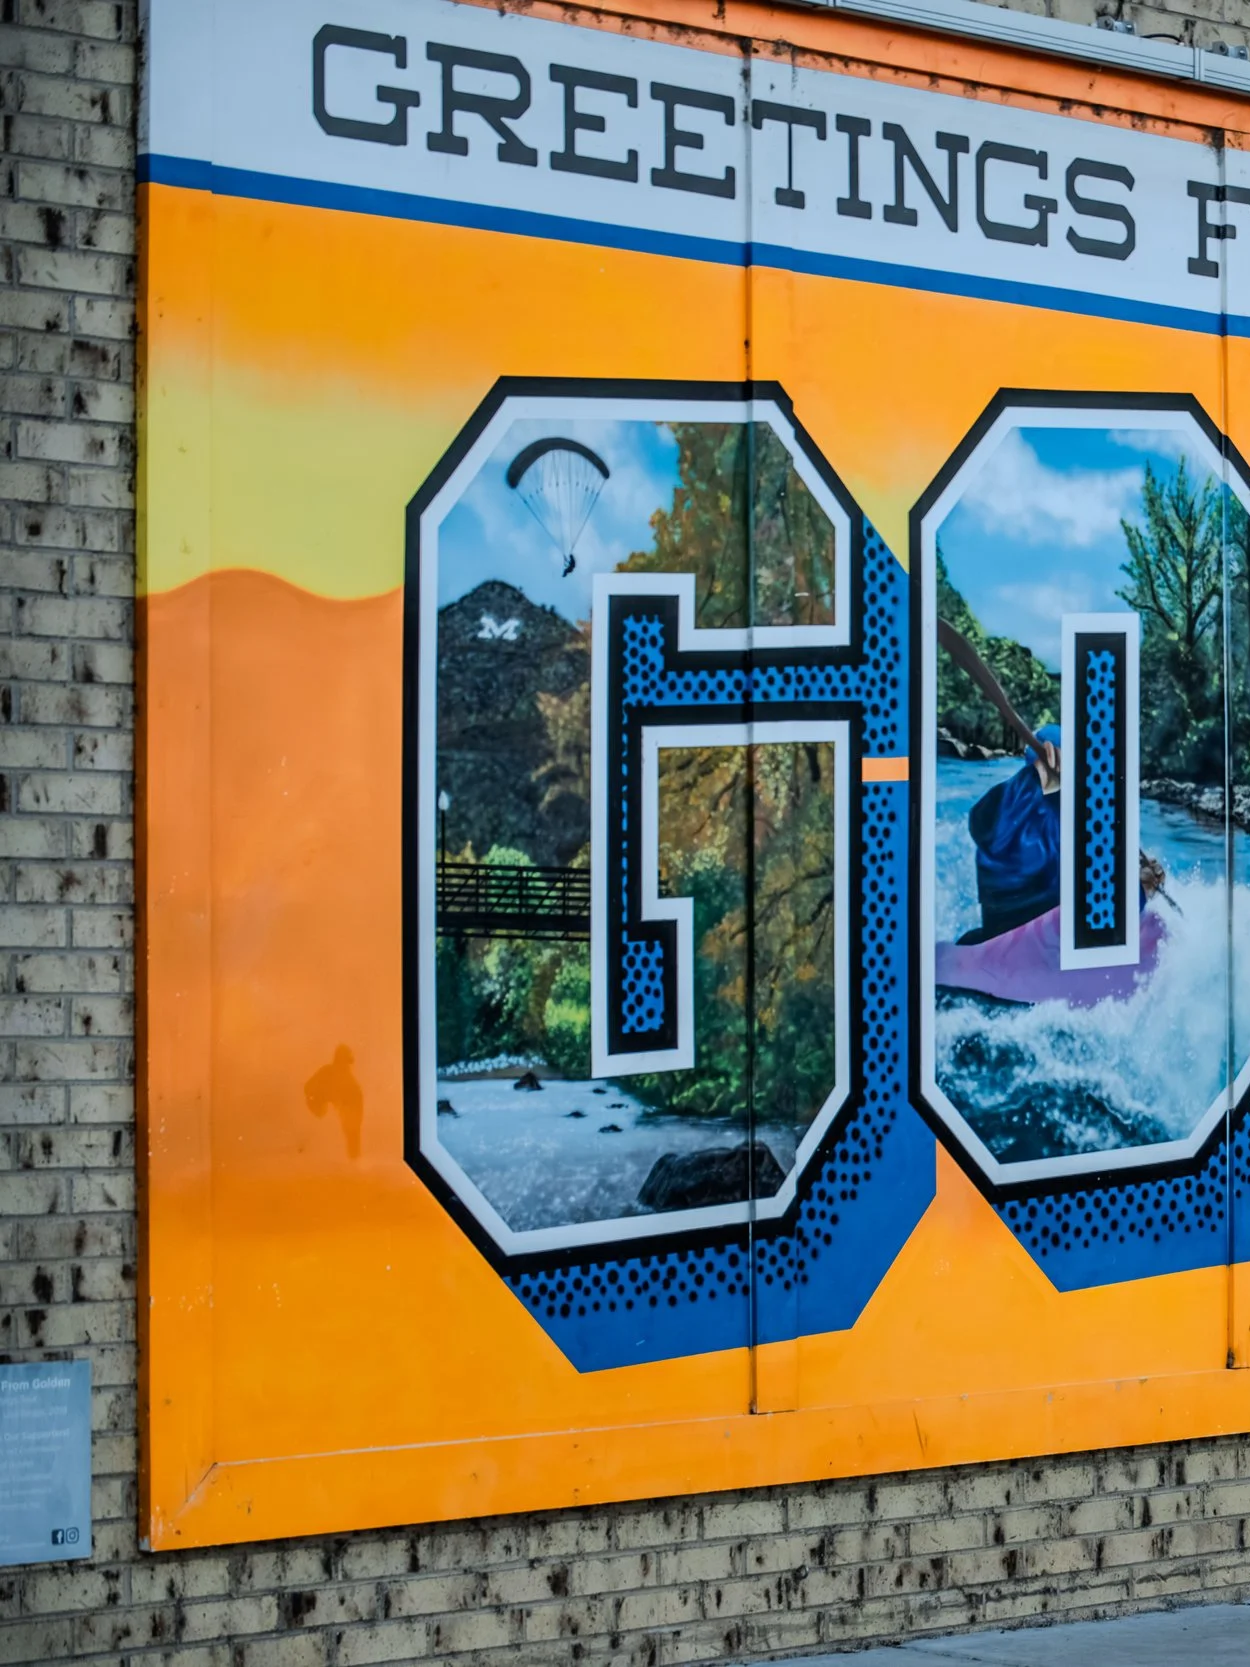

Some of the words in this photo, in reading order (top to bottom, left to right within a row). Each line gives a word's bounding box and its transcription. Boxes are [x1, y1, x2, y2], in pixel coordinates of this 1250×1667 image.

[312, 23, 1136, 261] GREETINGS
[1, 1379, 30, 1391] From
[32, 1376, 71, 1389] Golden
